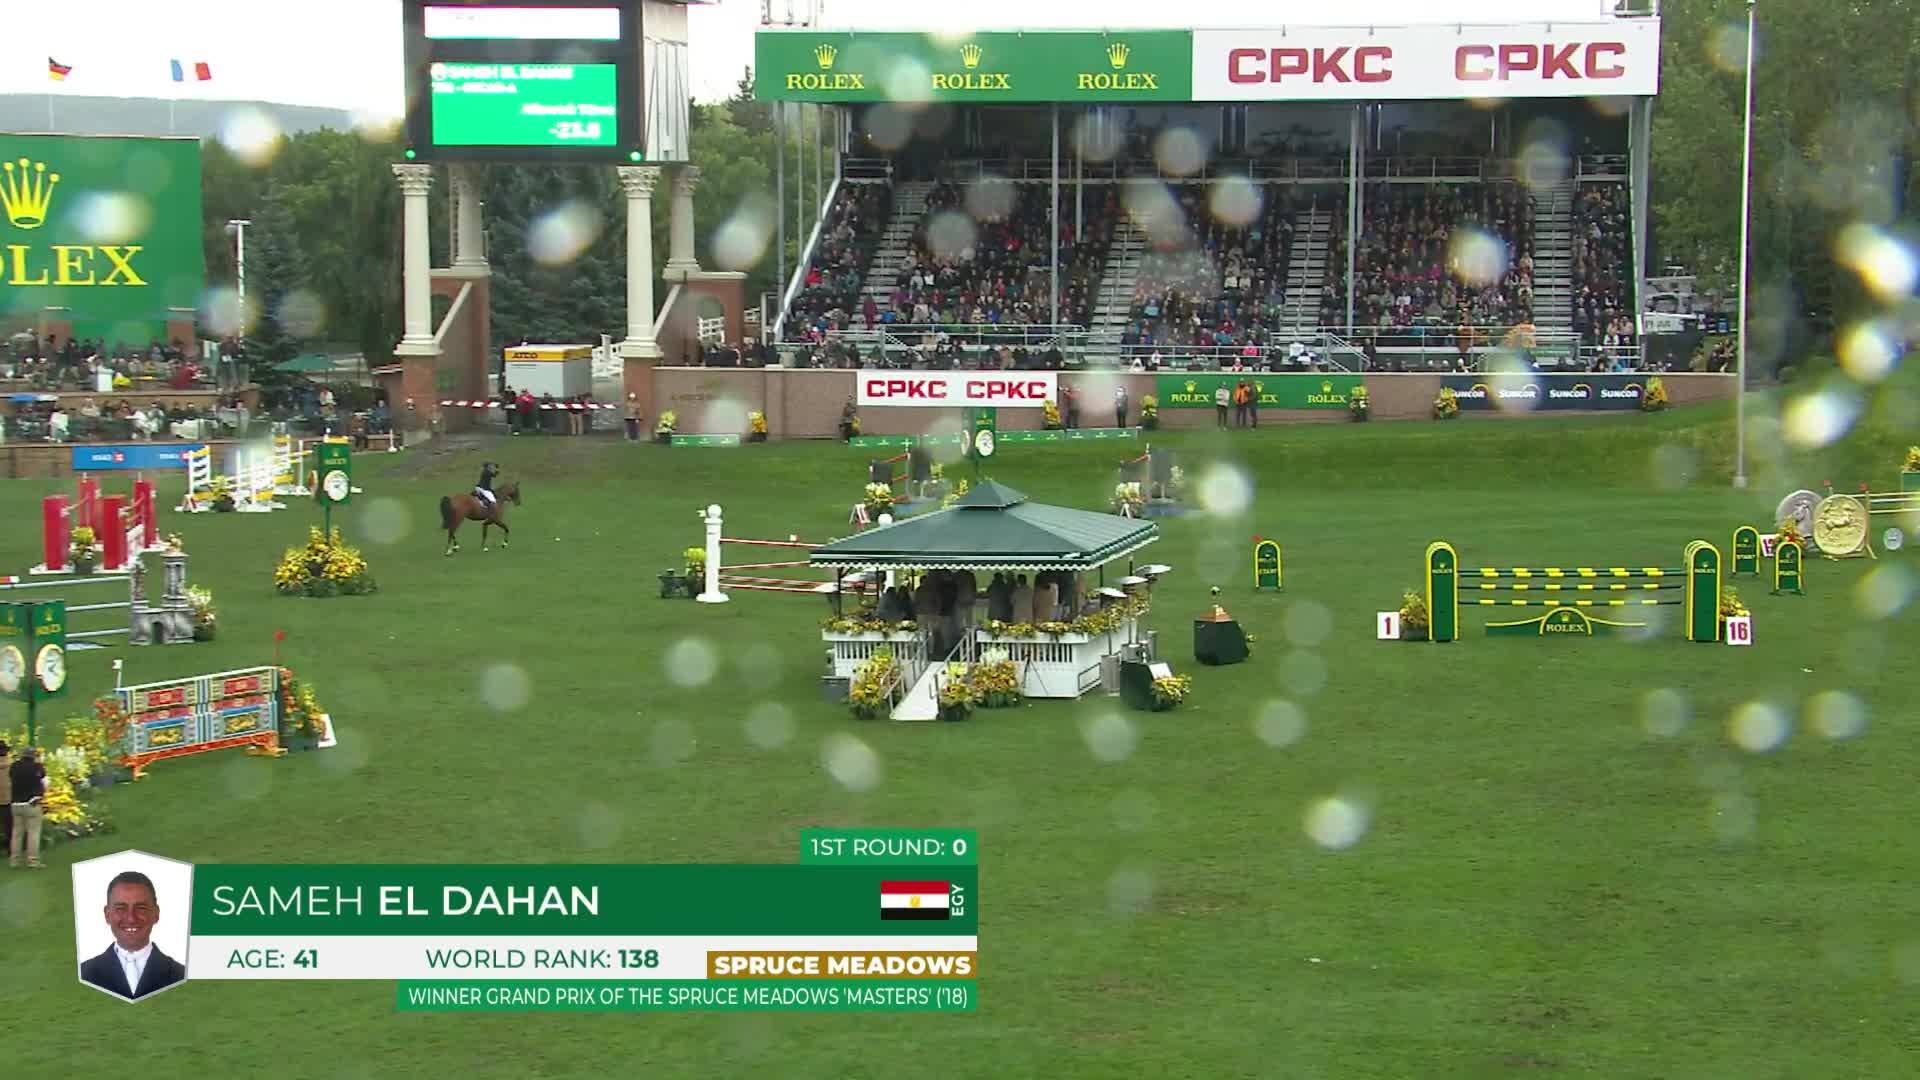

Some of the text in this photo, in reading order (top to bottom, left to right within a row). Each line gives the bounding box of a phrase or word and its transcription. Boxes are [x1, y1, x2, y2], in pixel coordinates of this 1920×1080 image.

[1228, 47, 1393, 84] CPKC
[1455, 42, 1627, 81] CPKC
[786, 73, 865, 90] ROLEX
[931, 73, 1011, 90] ROLEX
[1077, 73, 1159, 90] ROLEX
[0, 245, 149, 286] LEX
[866, 379, 1048, 399] CPKC CPKC
[1452, 389, 1485, 399] UNCOR
[1550, 388, 1588, 399] SUNCOR
[1600, 388, 1639, 399] SUNCOR
[1171, 393, 1210, 404] ROLEX
[1308, 393, 1347, 404] ROLEX
[1384, 616, 1392, 636] 1
[1545, 623, 1585, 633] ROLEX
[1729, 621, 1749, 641] 16
